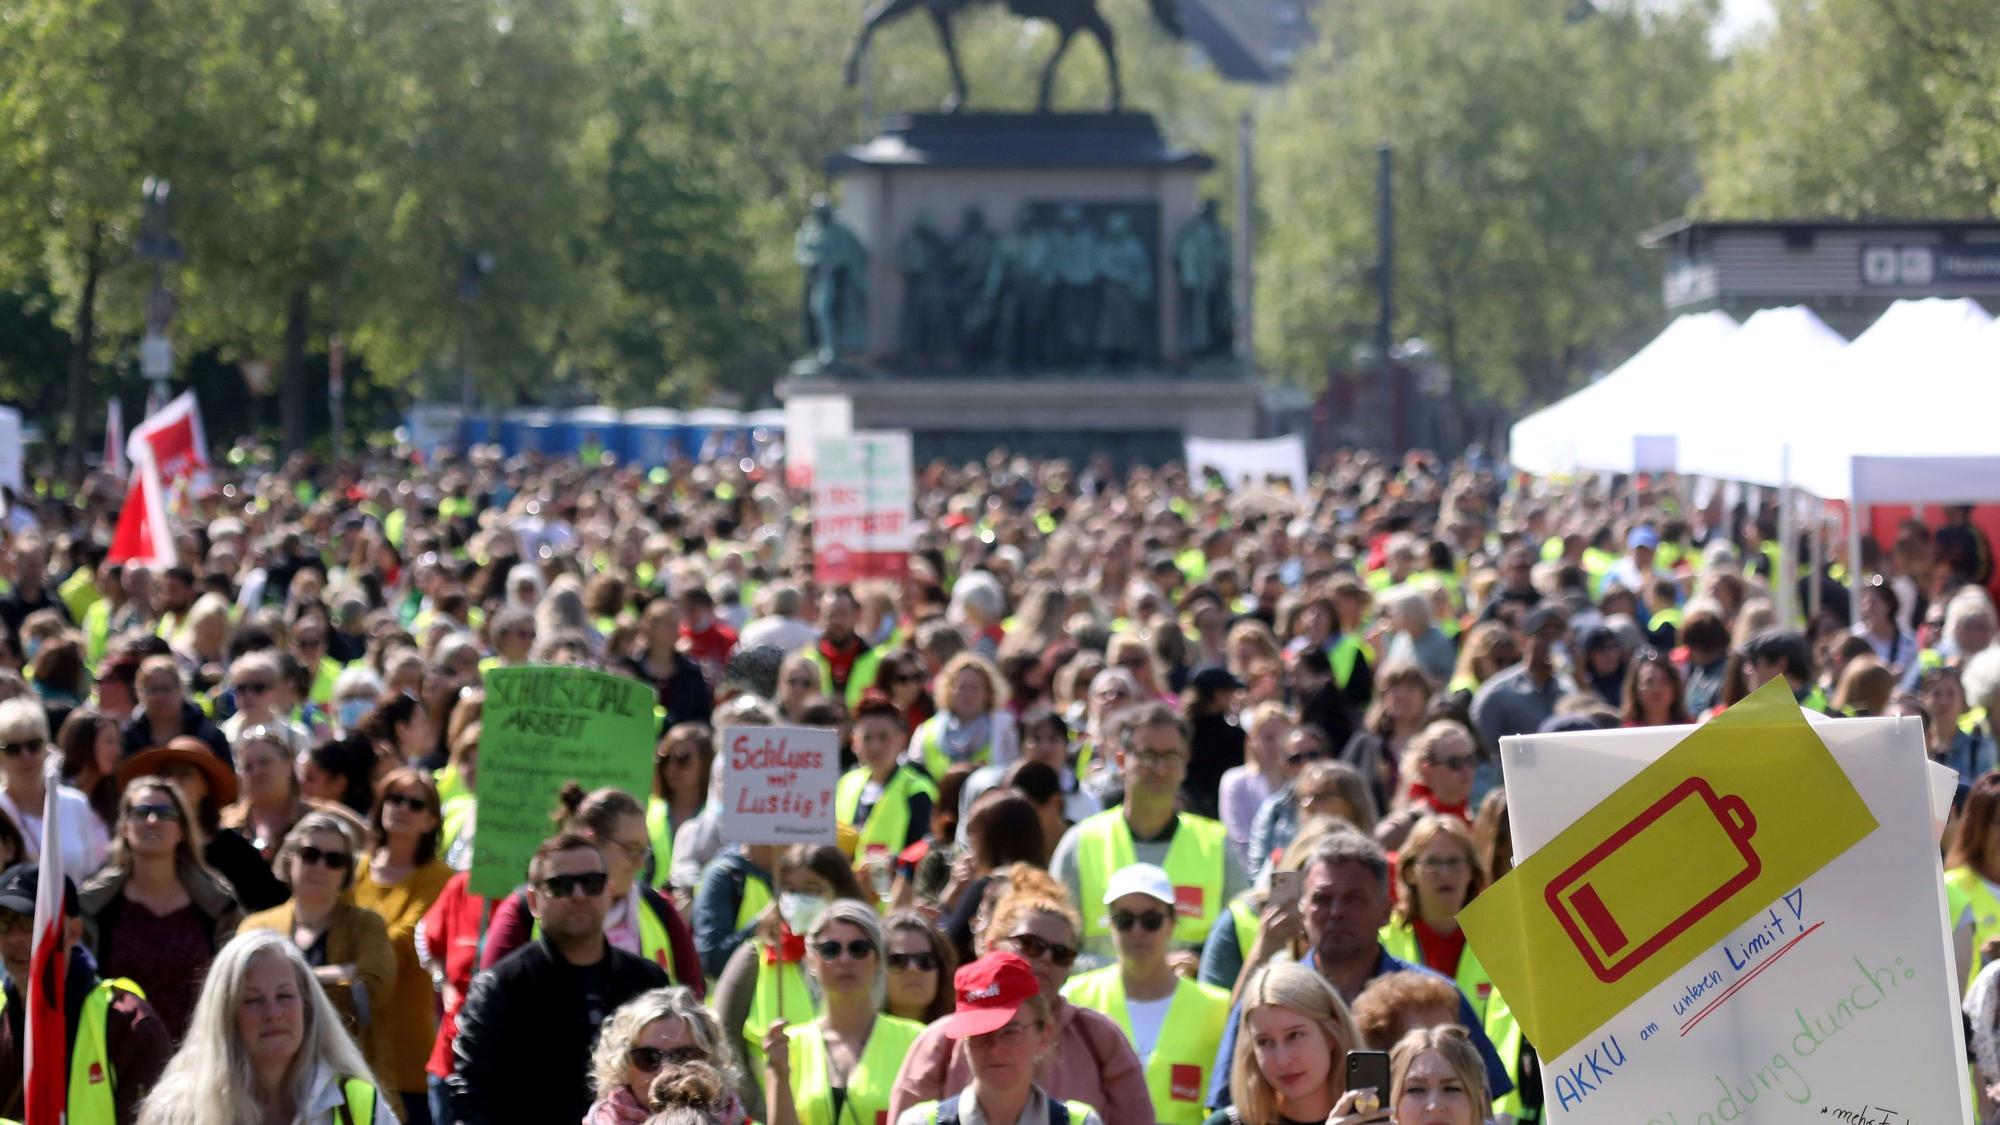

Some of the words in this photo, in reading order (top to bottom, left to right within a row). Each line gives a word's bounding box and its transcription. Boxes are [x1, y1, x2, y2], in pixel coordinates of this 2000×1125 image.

[498, 709, 593, 740] ARBEIT
[731, 734, 823, 771] Schluss
[766, 771, 798, 790] mit
[1555, 1035, 1627, 1112] AKKU
[1640, 1021, 1659, 1041] am
[1672, 970, 1723, 1016] unteren
